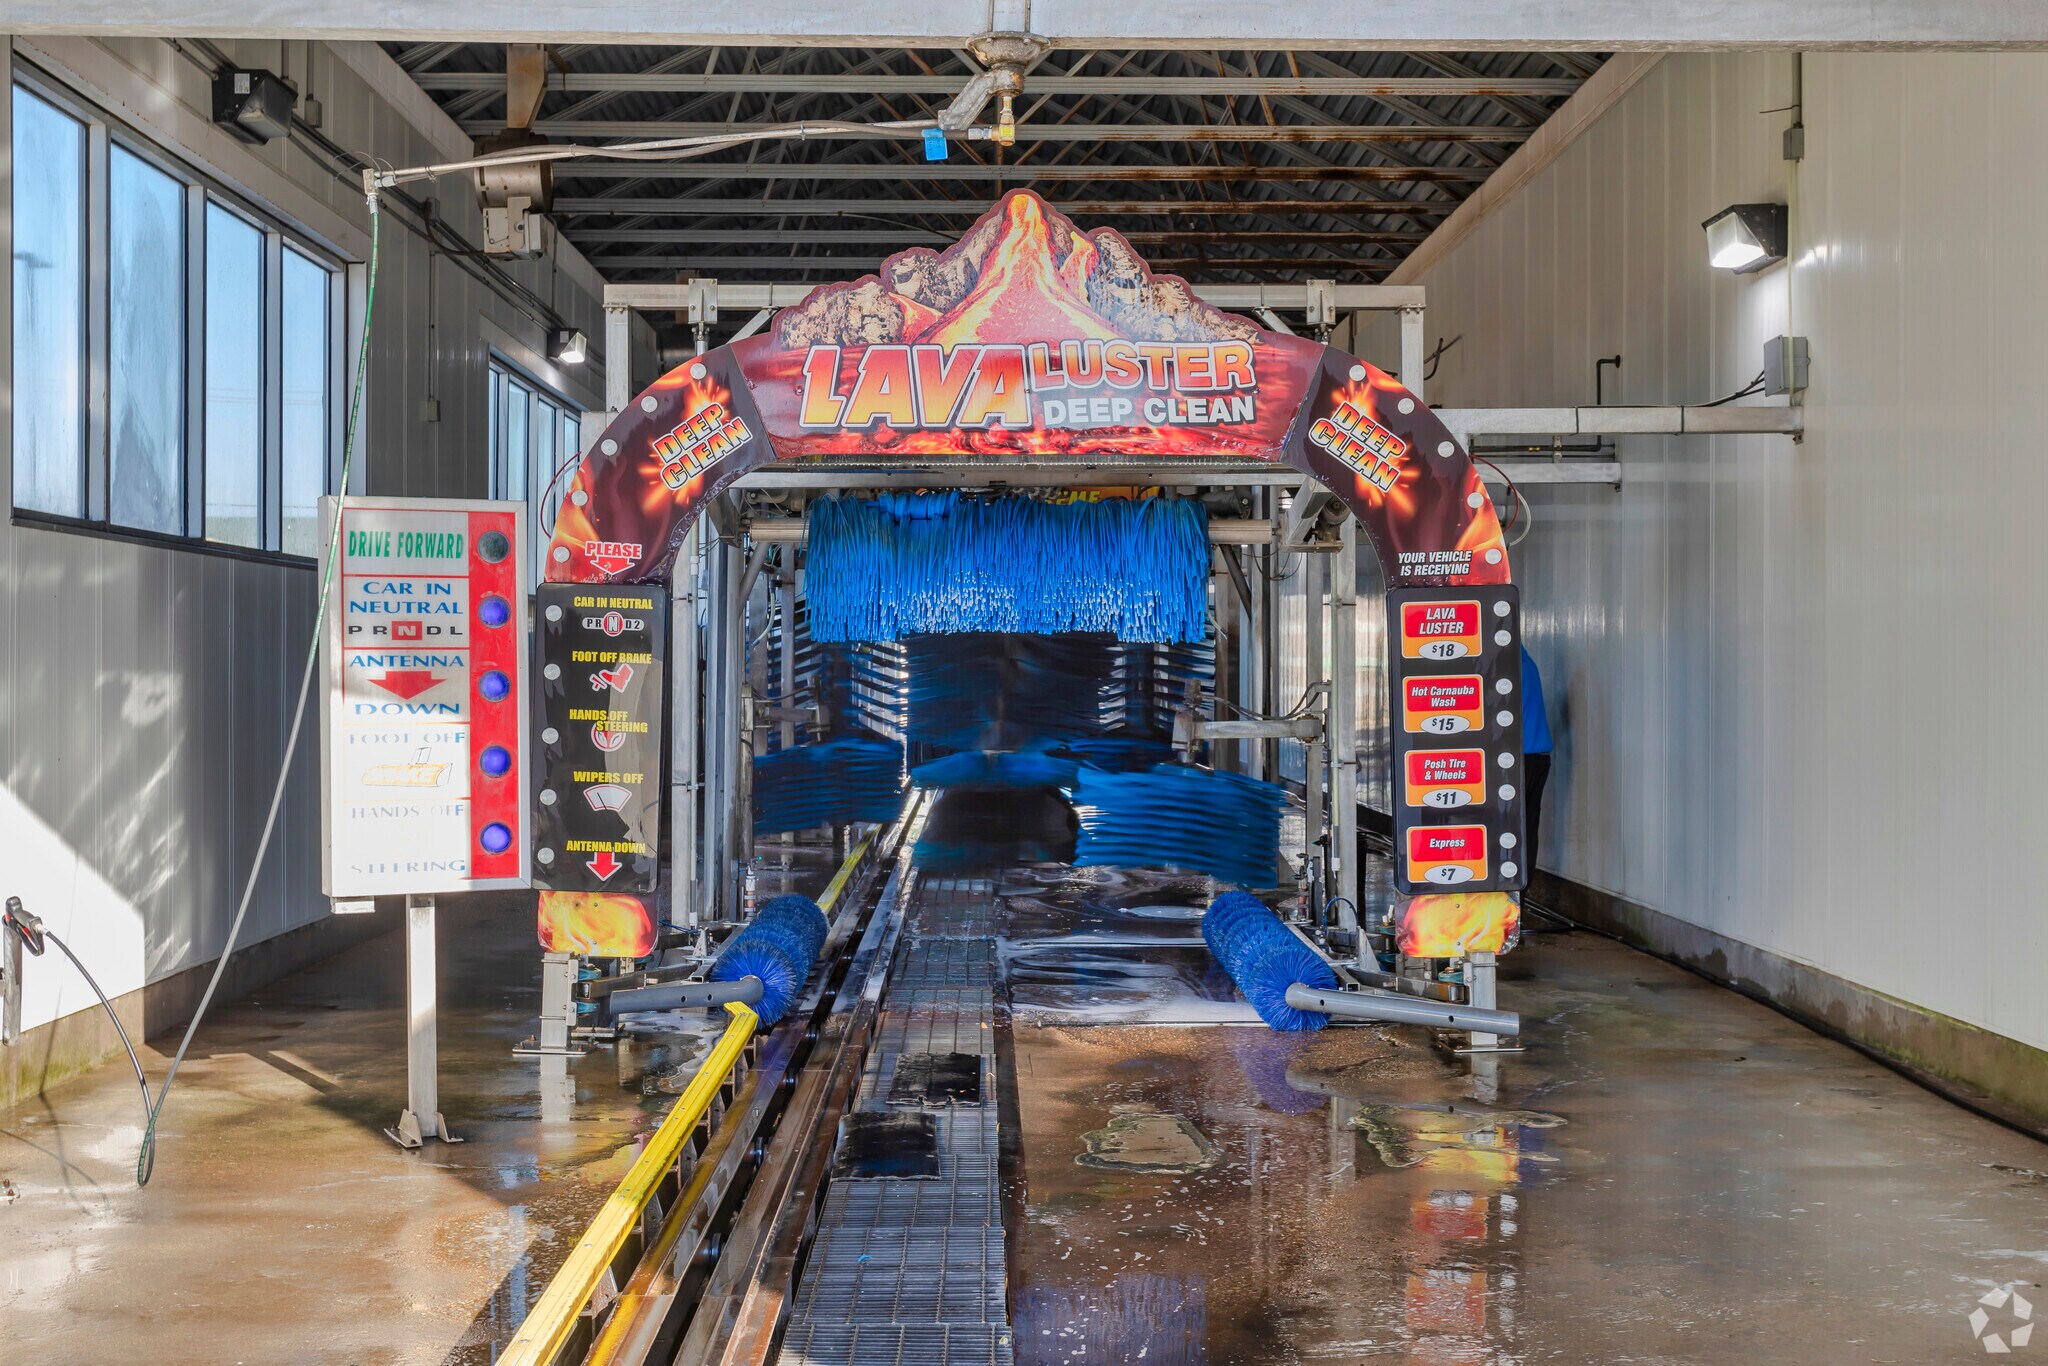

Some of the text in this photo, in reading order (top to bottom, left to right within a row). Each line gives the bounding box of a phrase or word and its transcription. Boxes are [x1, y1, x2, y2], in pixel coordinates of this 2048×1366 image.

[800, 339, 1257, 428] LAVA LUSTER
[1044, 396, 1255, 425] DEEP CLEAN
[653, 403, 723, 463] DEEP
[1332, 402, 1405, 459] DEEP
[661, 417, 752, 490] CLEAN
[1309, 419, 1400, 491] CLEAN
[348, 531, 464, 558] DRIVE FORWARD
[585, 541, 641, 558] PLEASE
[1398, 550, 1472, 563] YOUR VEHICLE
[1400, 563, 1470, 576] IS RECEIVING
[363, 582, 451, 595] CAR IN
[350, 601, 464, 614] NEUTRAL
[574, 596, 653, 610] CAR IN NEUTRAL
[1426, 608, 1456, 620] LAVA
[1419, 622, 1464, 635] LUSTER
[1432, 644, 1455, 657] $18
[350, 655, 464, 667] ANTENNA
[572, 651, 652, 664] FOOT OFF BRAKE
[1411, 685, 1475, 696] Hot Carnauba
[1431, 697, 1456, 707] Wash
[355, 703, 460, 715] DOWN
[569, 709, 628, 721] HANDS OFF
[596, 721, 648, 733] STEERING
[1432, 718, 1454, 731] $15
[1424, 758, 1466, 769] Posh Tire
[573, 771, 643, 784] WIPERS OFF
[1424, 770, 1466, 780] & Wheels
[1436, 792, 1456, 805] $11
[566, 841, 646, 853] ANTENNA DOWN
[1429, 838, 1465, 850] Express
[1441, 868, 1456, 881] $7
